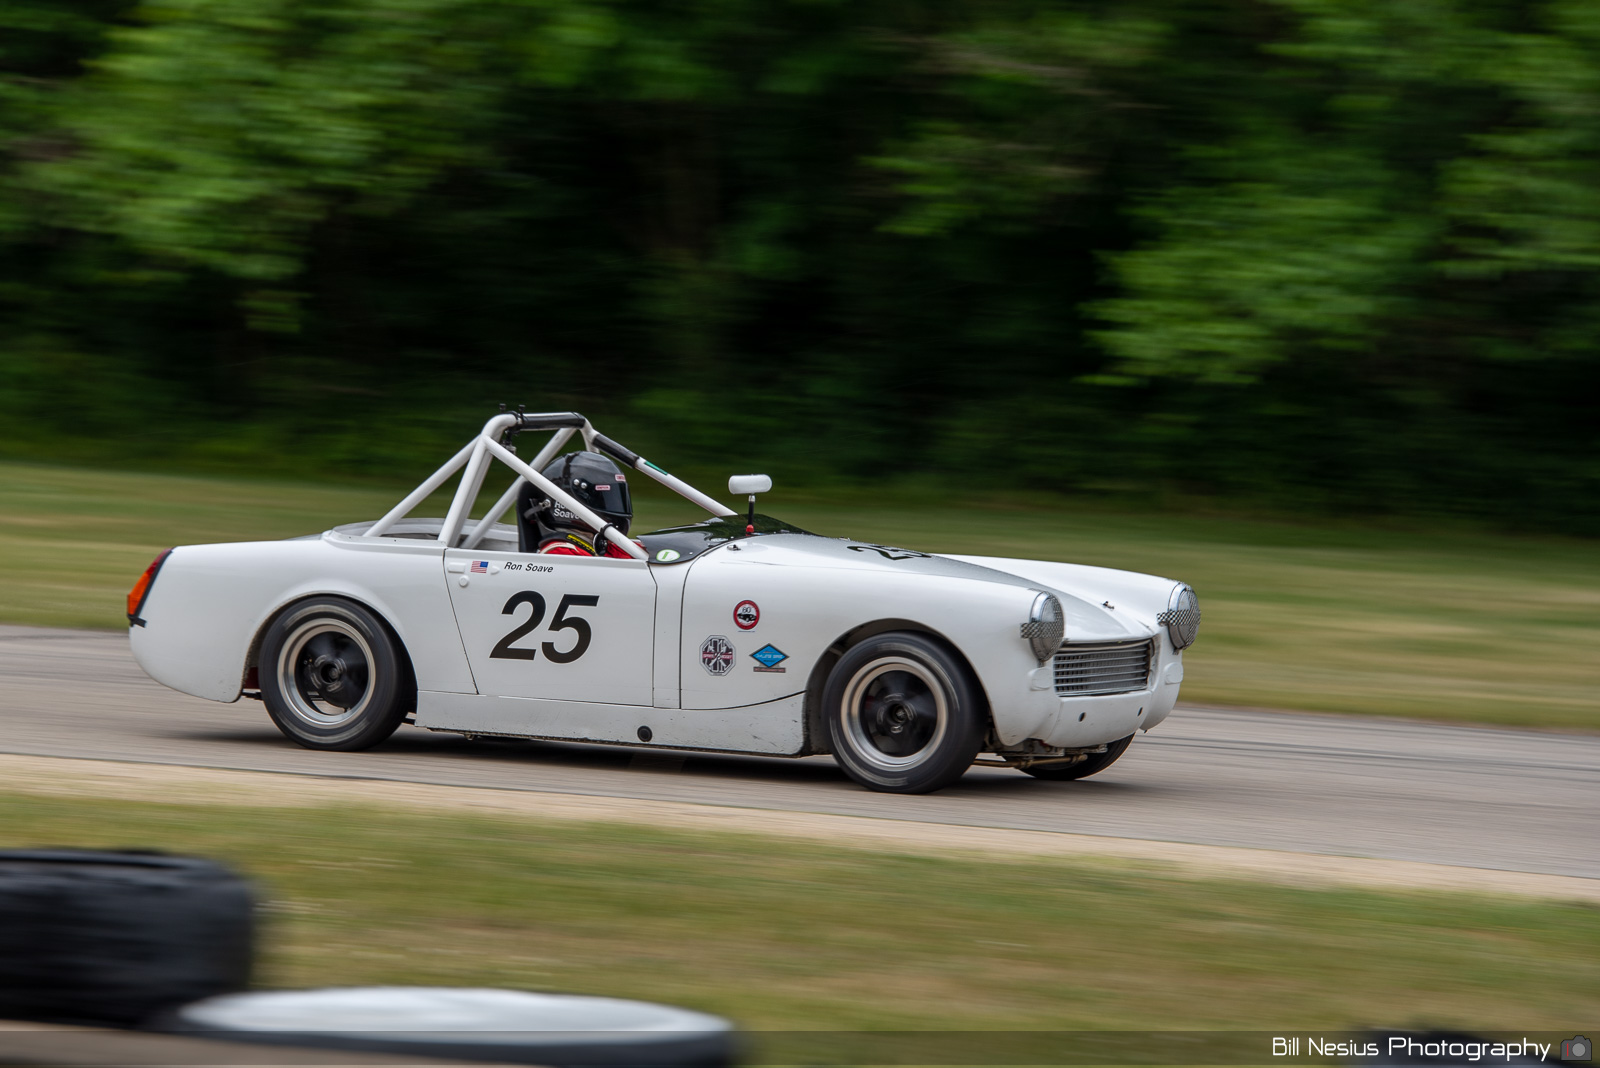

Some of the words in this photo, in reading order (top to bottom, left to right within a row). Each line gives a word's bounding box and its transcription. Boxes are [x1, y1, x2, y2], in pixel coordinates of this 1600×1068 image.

[504, 561, 523, 571] Ron
[525, 562, 554, 573] Soave
[489, 590, 600, 664] 25
